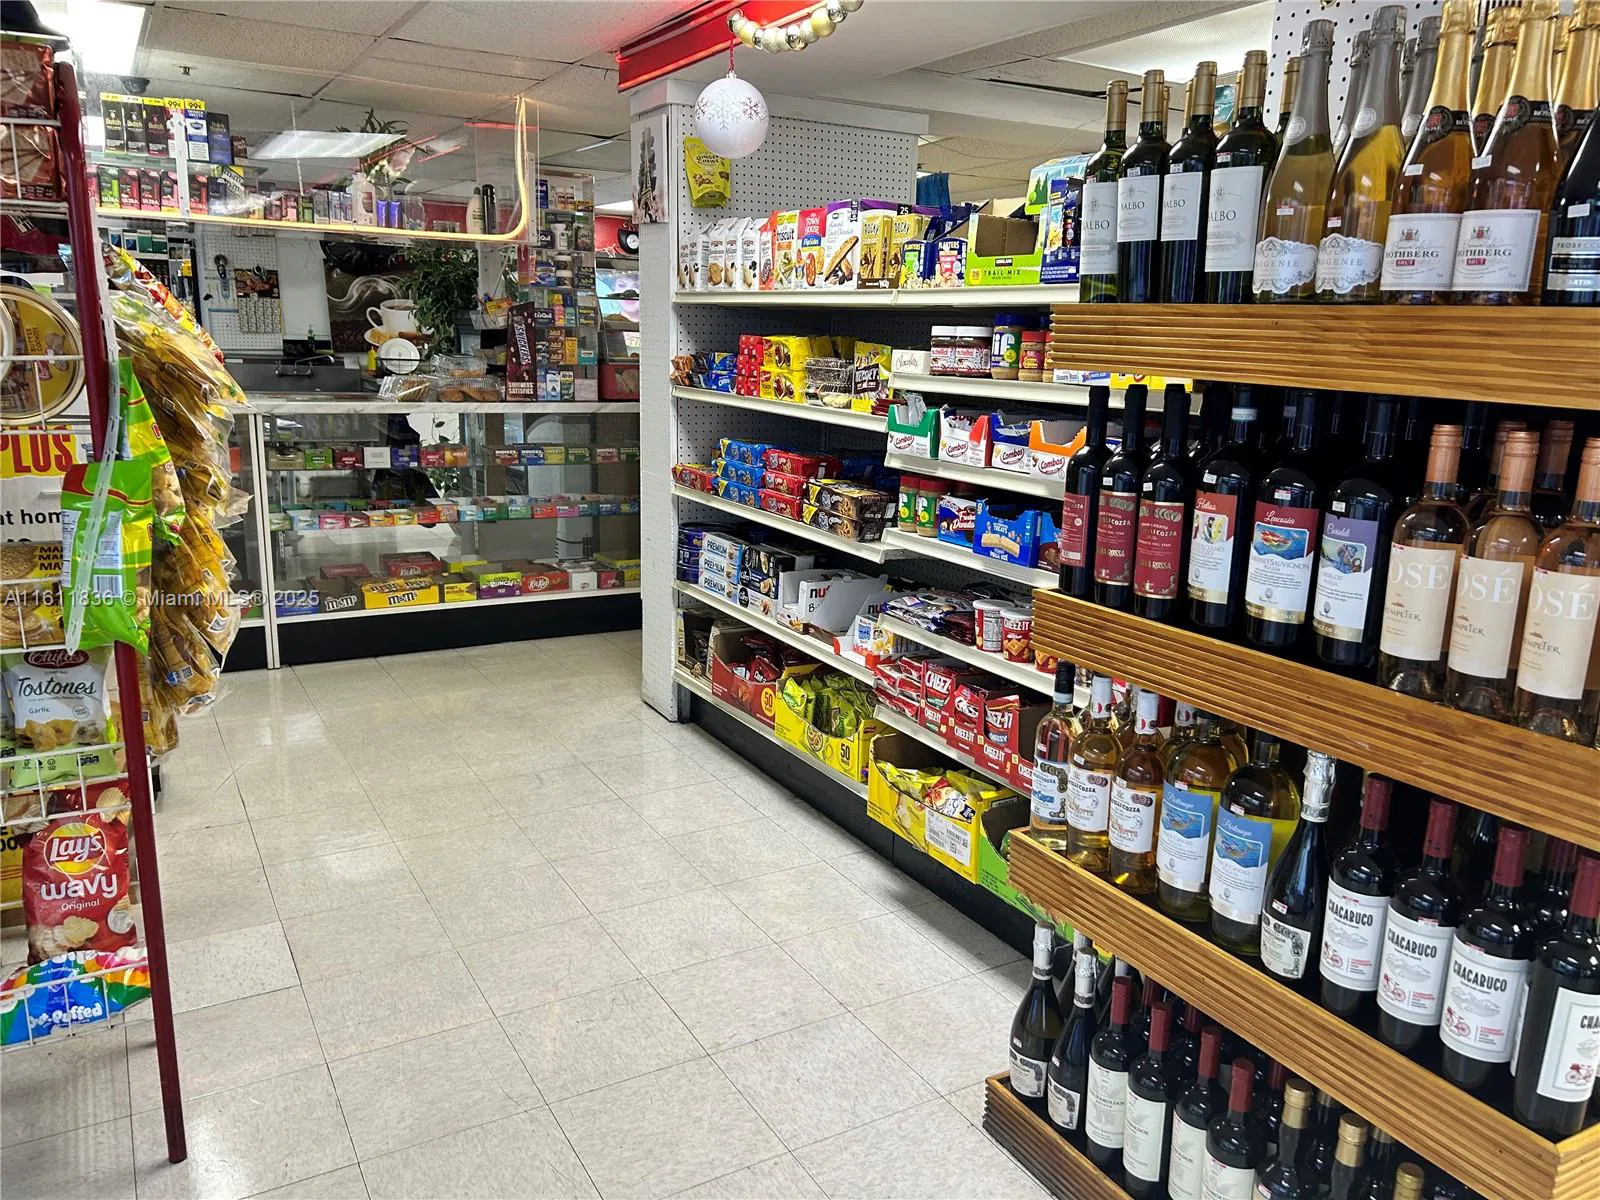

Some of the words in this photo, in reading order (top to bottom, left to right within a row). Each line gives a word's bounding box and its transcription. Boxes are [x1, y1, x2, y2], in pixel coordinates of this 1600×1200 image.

[514, 323, 532, 365] SNICKERS
[895, 435, 915, 446] Combos
[947, 442, 968, 453] Combos
[1002, 448, 1023, 460] Combos
[1040, 457, 1065, 470] Combos
[21, 509, 62, 525] hom
[707, 540, 728, 555] PREMIUM
[40, 562, 62, 570] MA
[704, 577, 726, 592] PREMIUM
[1003, 618, 1030, 632] CHEEZ-IT
[18, 677, 97, 697] Tostones
[925, 670, 951, 694] CHEEZ
[764, 689, 773, 708] 50
[29, 706, 50, 714] Garlic
[840, 743, 850, 761] 50
[50, 834, 102, 863] Lay's
[40, 872, 118, 901] wavy
[61, 899, 100, 911] Original
[1328, 898, 1374, 927] CHACABUCO
[1387, 927, 1437, 958] CHACABUCO
[1453, 959, 1508, 993] CHACABUCO
